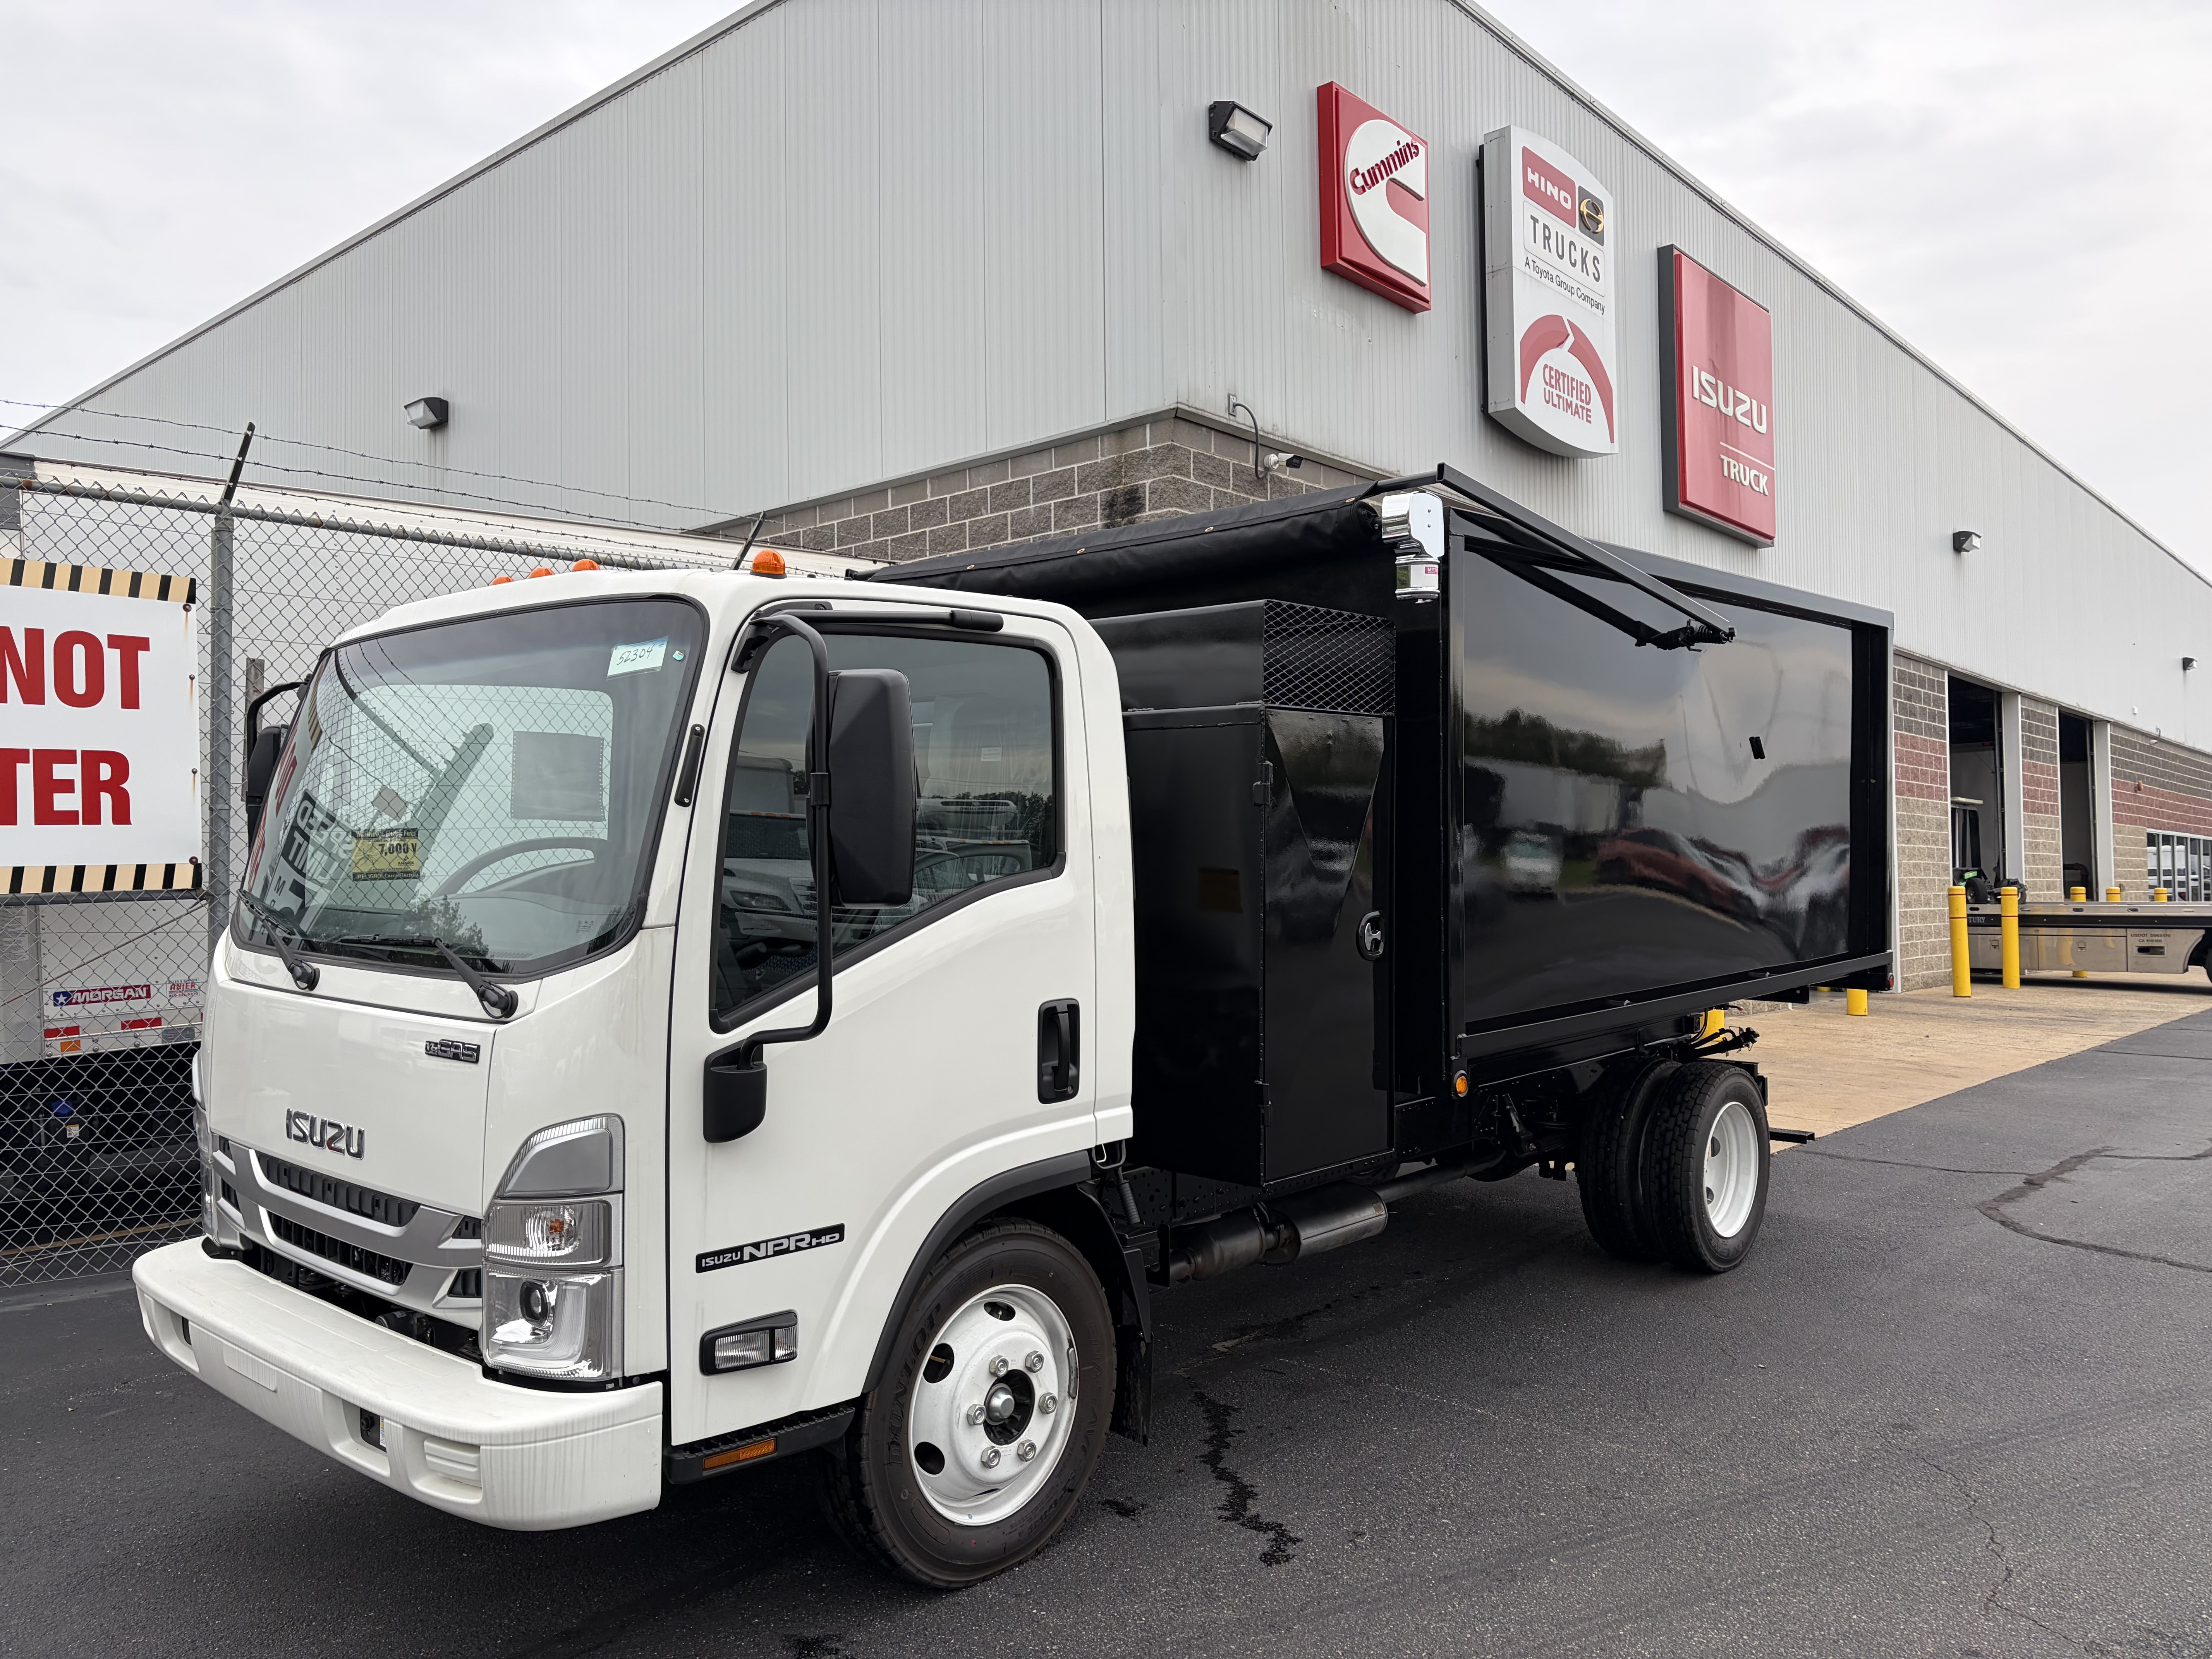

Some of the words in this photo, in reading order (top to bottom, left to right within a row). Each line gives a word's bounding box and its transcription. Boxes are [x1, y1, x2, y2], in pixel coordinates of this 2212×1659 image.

[1350, 139, 1419, 195] Cummins
[1527, 167, 1571, 210] HINO
[1530, 215, 1600, 282] TRUCKS
[1525, 256, 1530, 269] A
[1532, 260, 1554, 283] Toyota
[1556, 275, 1575, 296] Group
[1577, 287, 1604, 315] Company
[1543, 364, 1591, 405] CERTIFIED
[1544, 387, 1591, 424] ULTIMATE
[1692, 365, 1767, 434] ISUZU
[1720, 454, 1769, 496] TRUCK
[0, 626, 150, 709] NOT
[617, 644, 655, 665] 52304
[72, 987, 147, 1003] MORGAN
[438, 1040, 477, 1062] GAS
[286, 1108, 365, 1160] ISUZU
[702, 1251, 740, 1267] ISUZU
[744, 1234, 811, 1261] NPR
[812, 1233, 840, 1246] HD
[886, 1303, 941, 1467] DUNLOP
